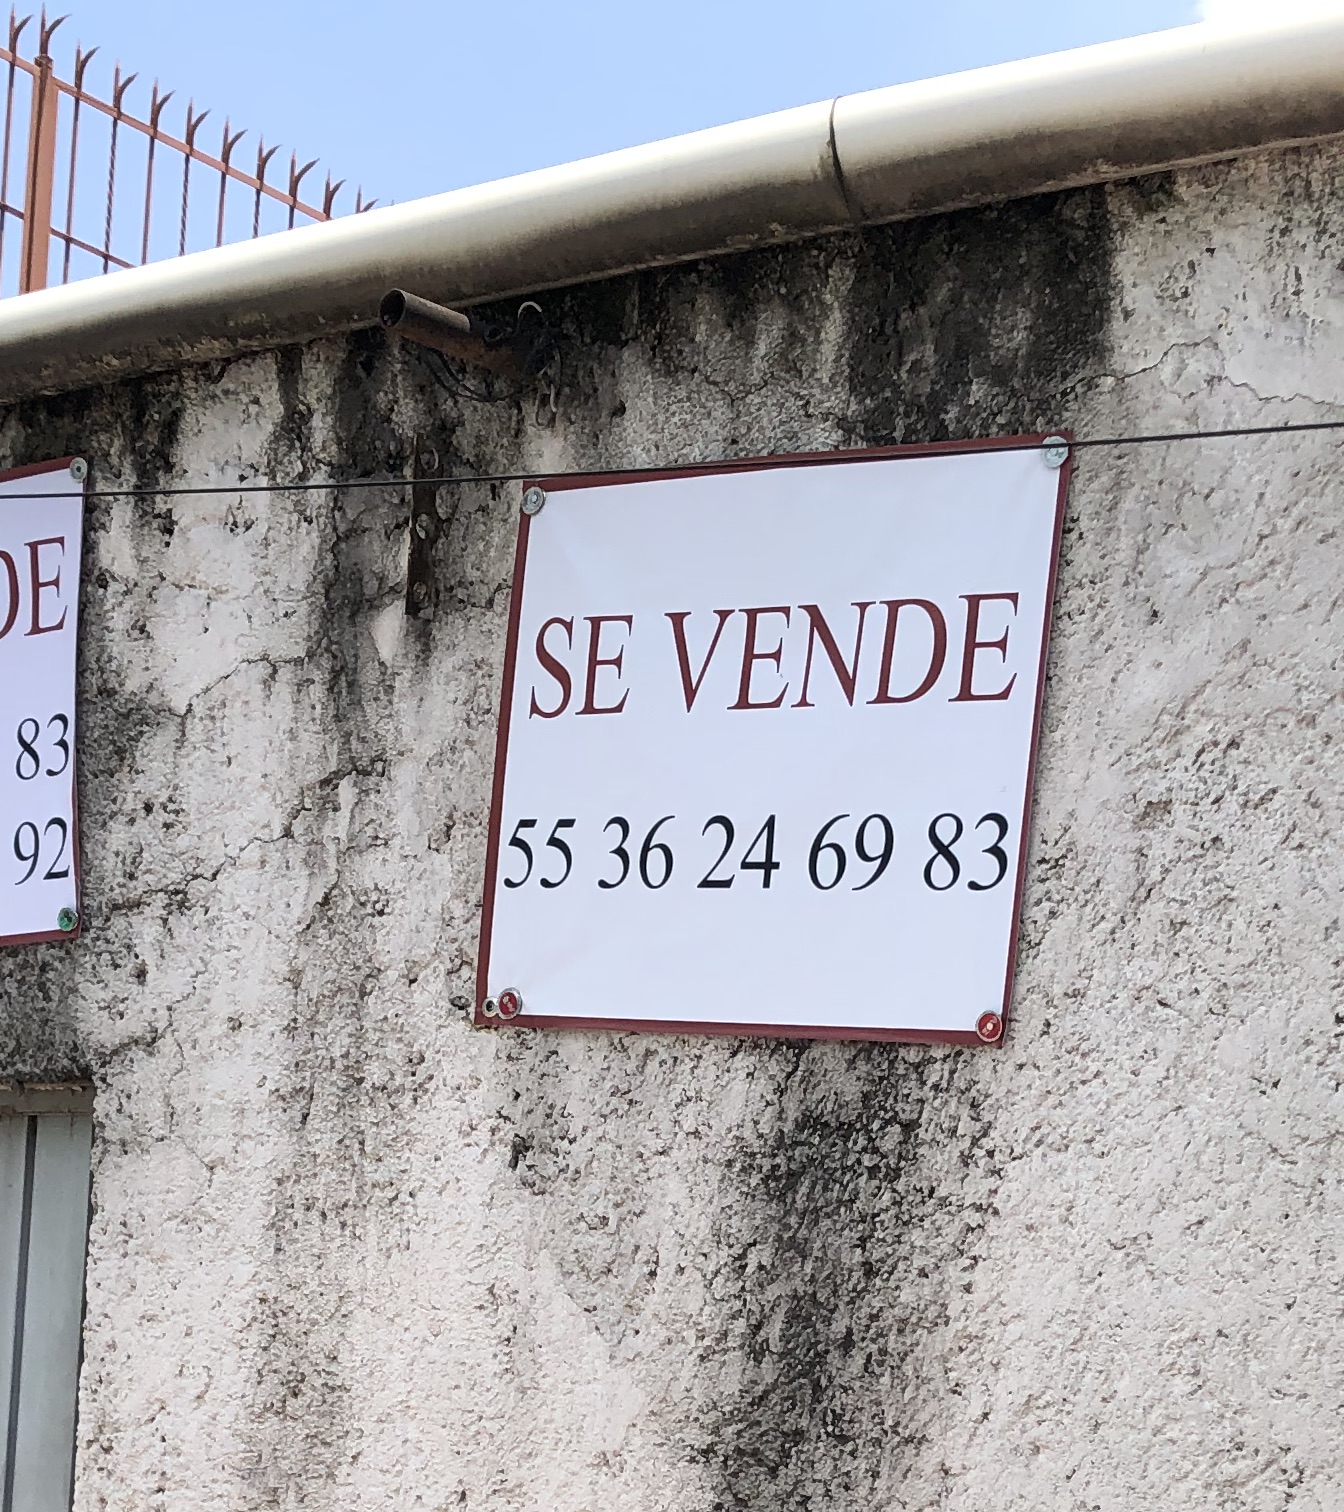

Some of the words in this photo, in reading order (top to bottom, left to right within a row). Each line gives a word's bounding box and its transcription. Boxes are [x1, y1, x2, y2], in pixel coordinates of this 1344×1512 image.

[529, 614, 633, 719] SE
[664, 592, 1019, 713] VENDE
[16, 713, 70, 780] 83
[14, 816, 71, 886] 92
[503, 818, 576, 888] 55
[597, 815, 675, 889] 36
[697, 814, 780, 888] 24
[808, 813, 894, 891] 69
[923, 812, 1009, 891] 83
